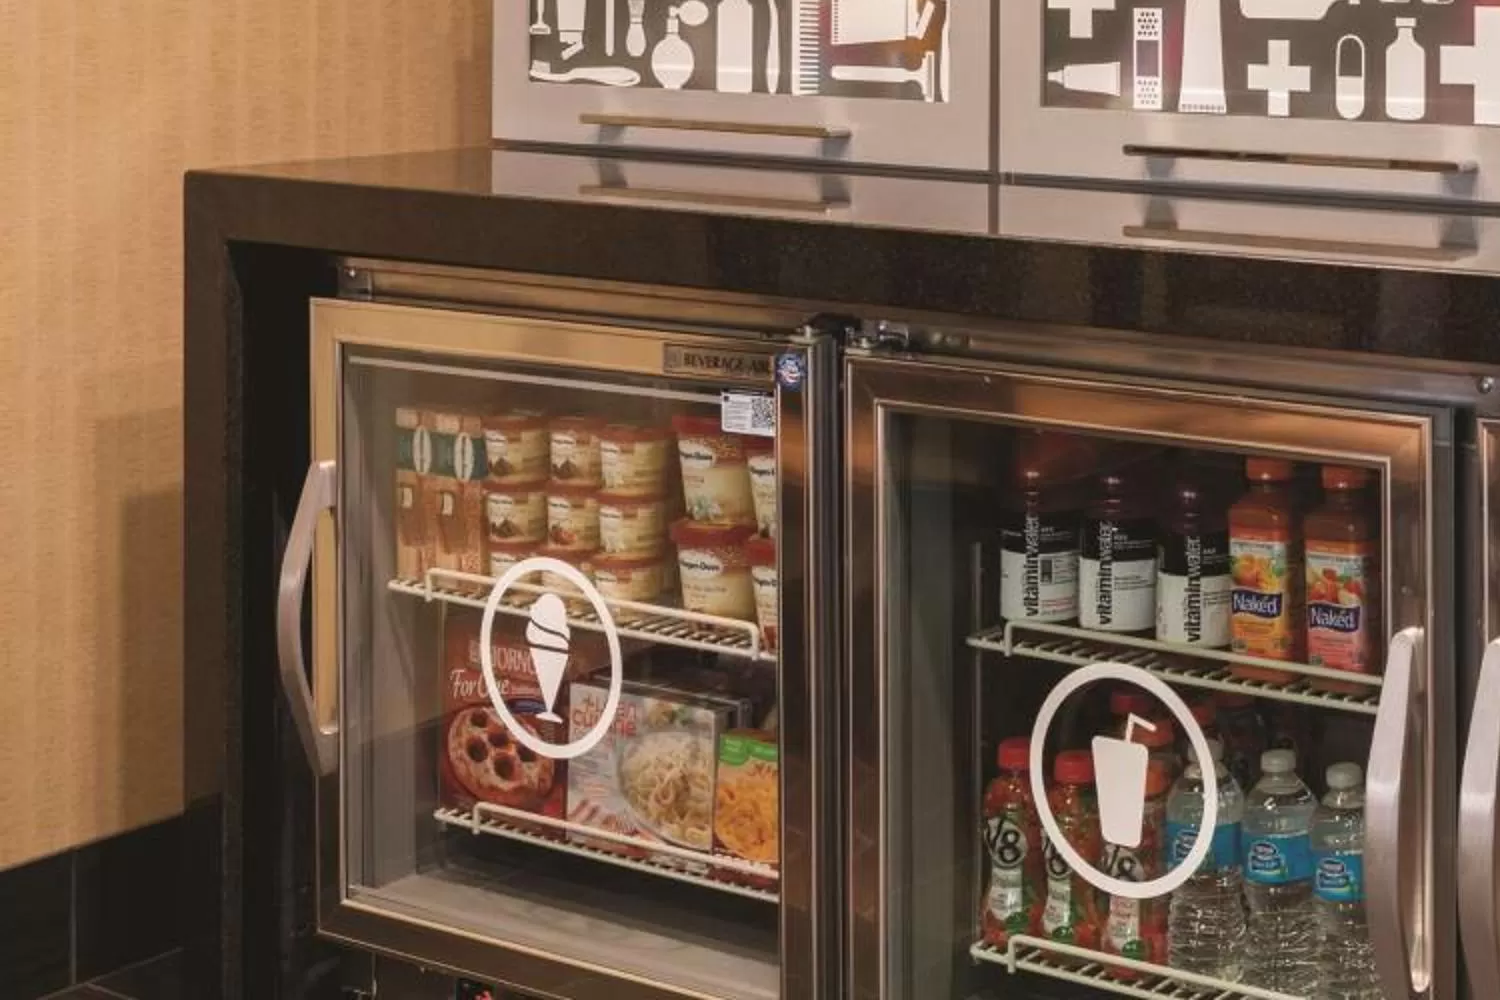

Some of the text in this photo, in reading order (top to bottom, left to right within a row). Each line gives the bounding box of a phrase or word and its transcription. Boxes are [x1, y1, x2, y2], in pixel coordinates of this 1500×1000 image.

[1311, 607, 1356, 628] Naked
[477, 674, 510, 698] Oe
[986, 817, 1021, 863] V8
